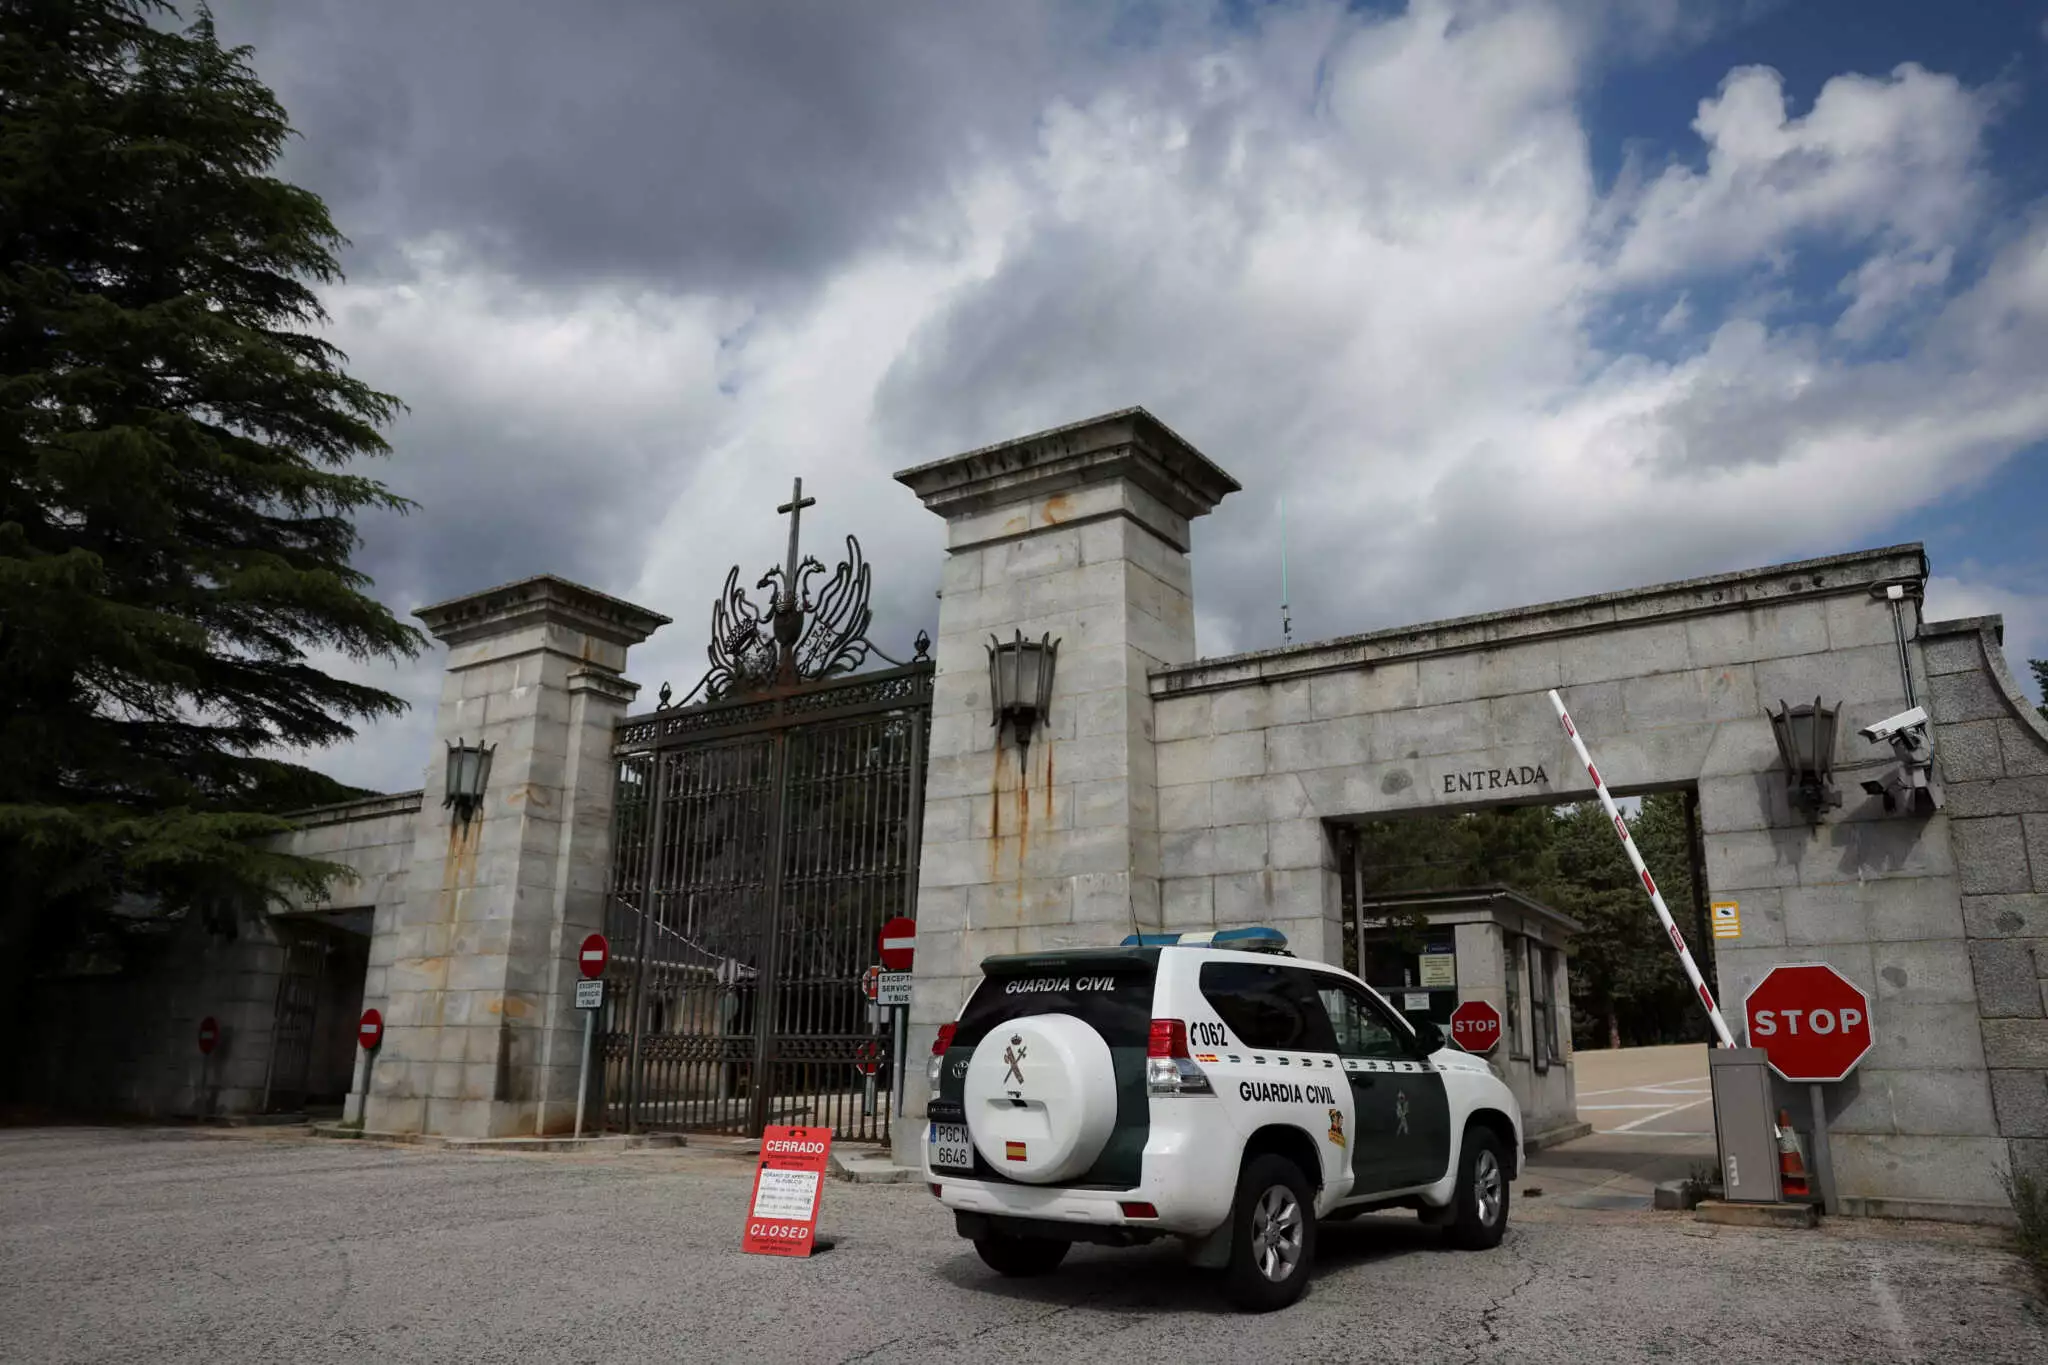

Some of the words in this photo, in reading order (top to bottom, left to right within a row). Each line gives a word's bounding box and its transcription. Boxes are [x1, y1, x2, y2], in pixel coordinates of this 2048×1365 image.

[1443, 765, 1549, 794] ENTRADA
[881, 975, 912, 983] EXCEPT
[1005, 978, 1070, 994] GUARDIA
[1076, 977, 1115, 991] CIVIL
[1455, 1020, 1497, 1033] STOP
[1754, 1008, 1862, 1035] STOP
[1200, 1021, 1228, 1046] 062
[1239, 1081, 1303, 1104] GUARDIA
[1306, 1085, 1336, 1105] CIVIL
[938, 1126, 970, 1144] PGCN
[766, 1140, 824, 1153] CERRADO
[938, 1147, 967, 1165] 6646
[750, 1224, 808, 1238] CLOSED
